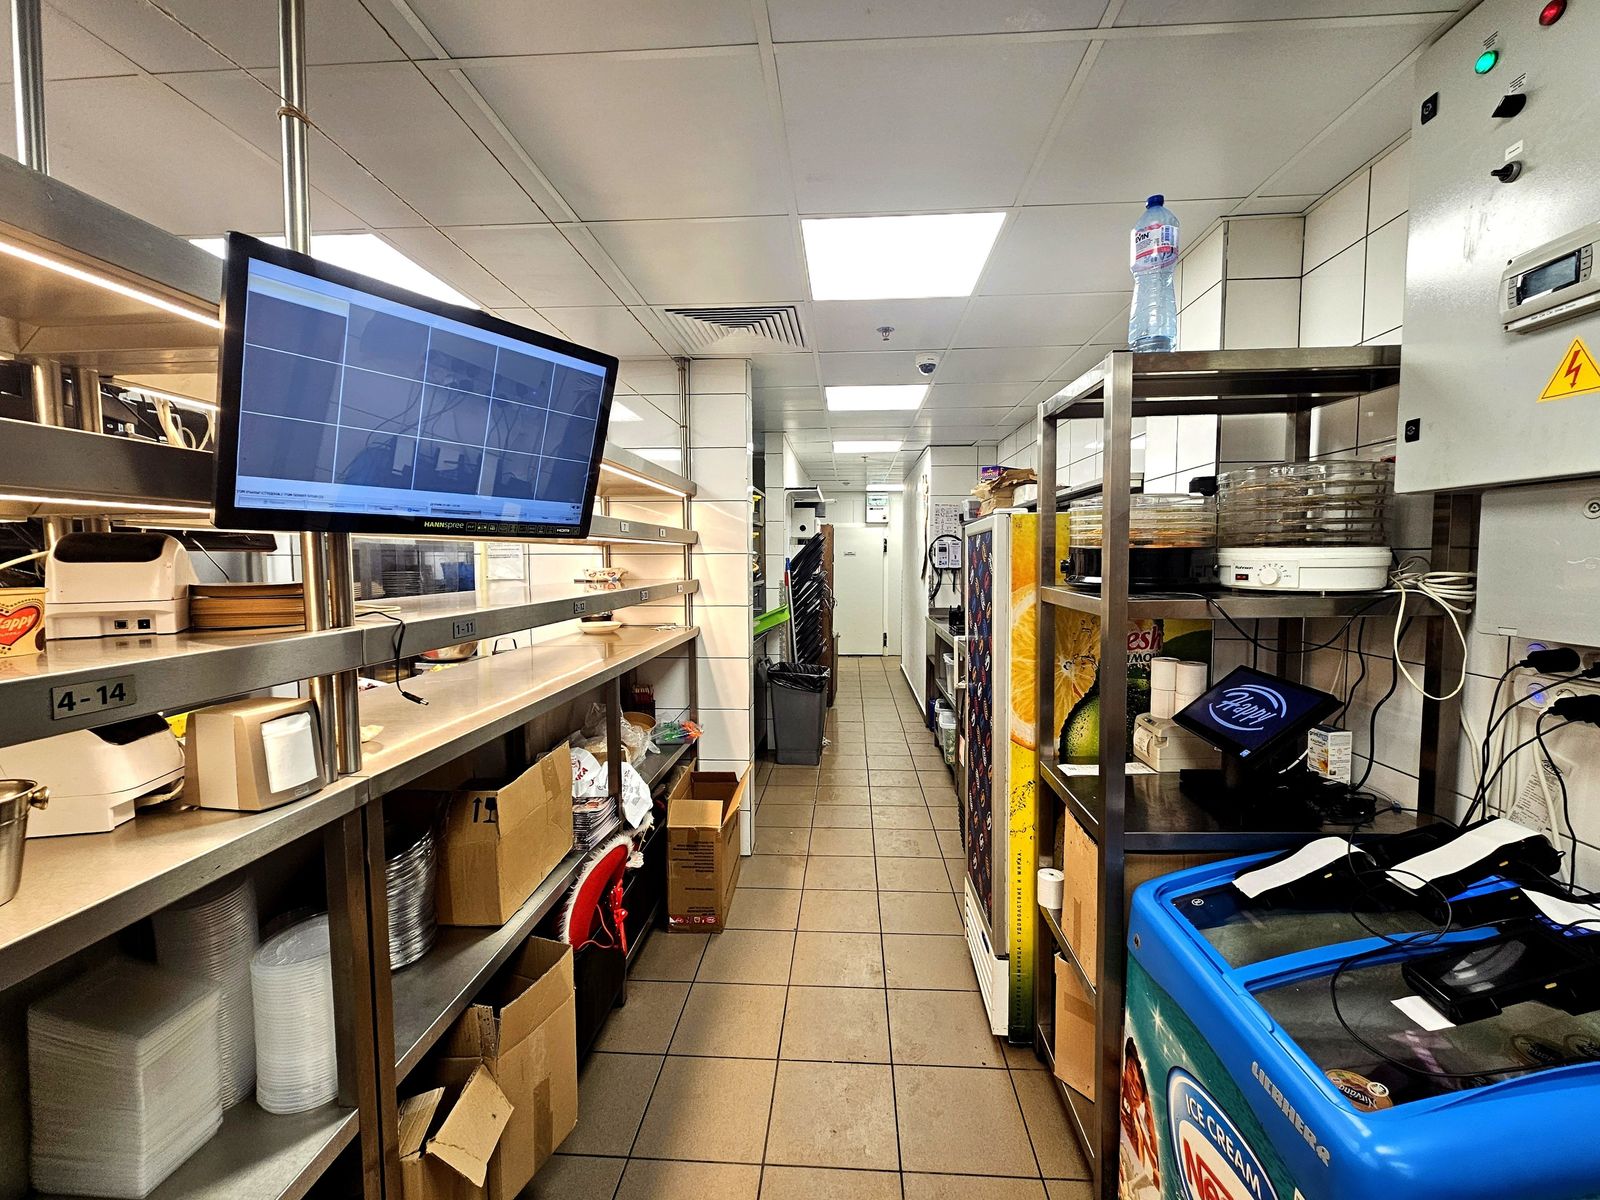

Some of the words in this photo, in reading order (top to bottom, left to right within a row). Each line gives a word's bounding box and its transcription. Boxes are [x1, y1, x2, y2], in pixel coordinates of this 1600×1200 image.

[424, 521, 464, 529] HANNspree
[1127, 625, 1162, 651] esh
[1216, 692, 1277, 725] Happy
[1185, 1093, 1205, 1128] ICE
[1206, 1115, 1262, 1198] CREAM
